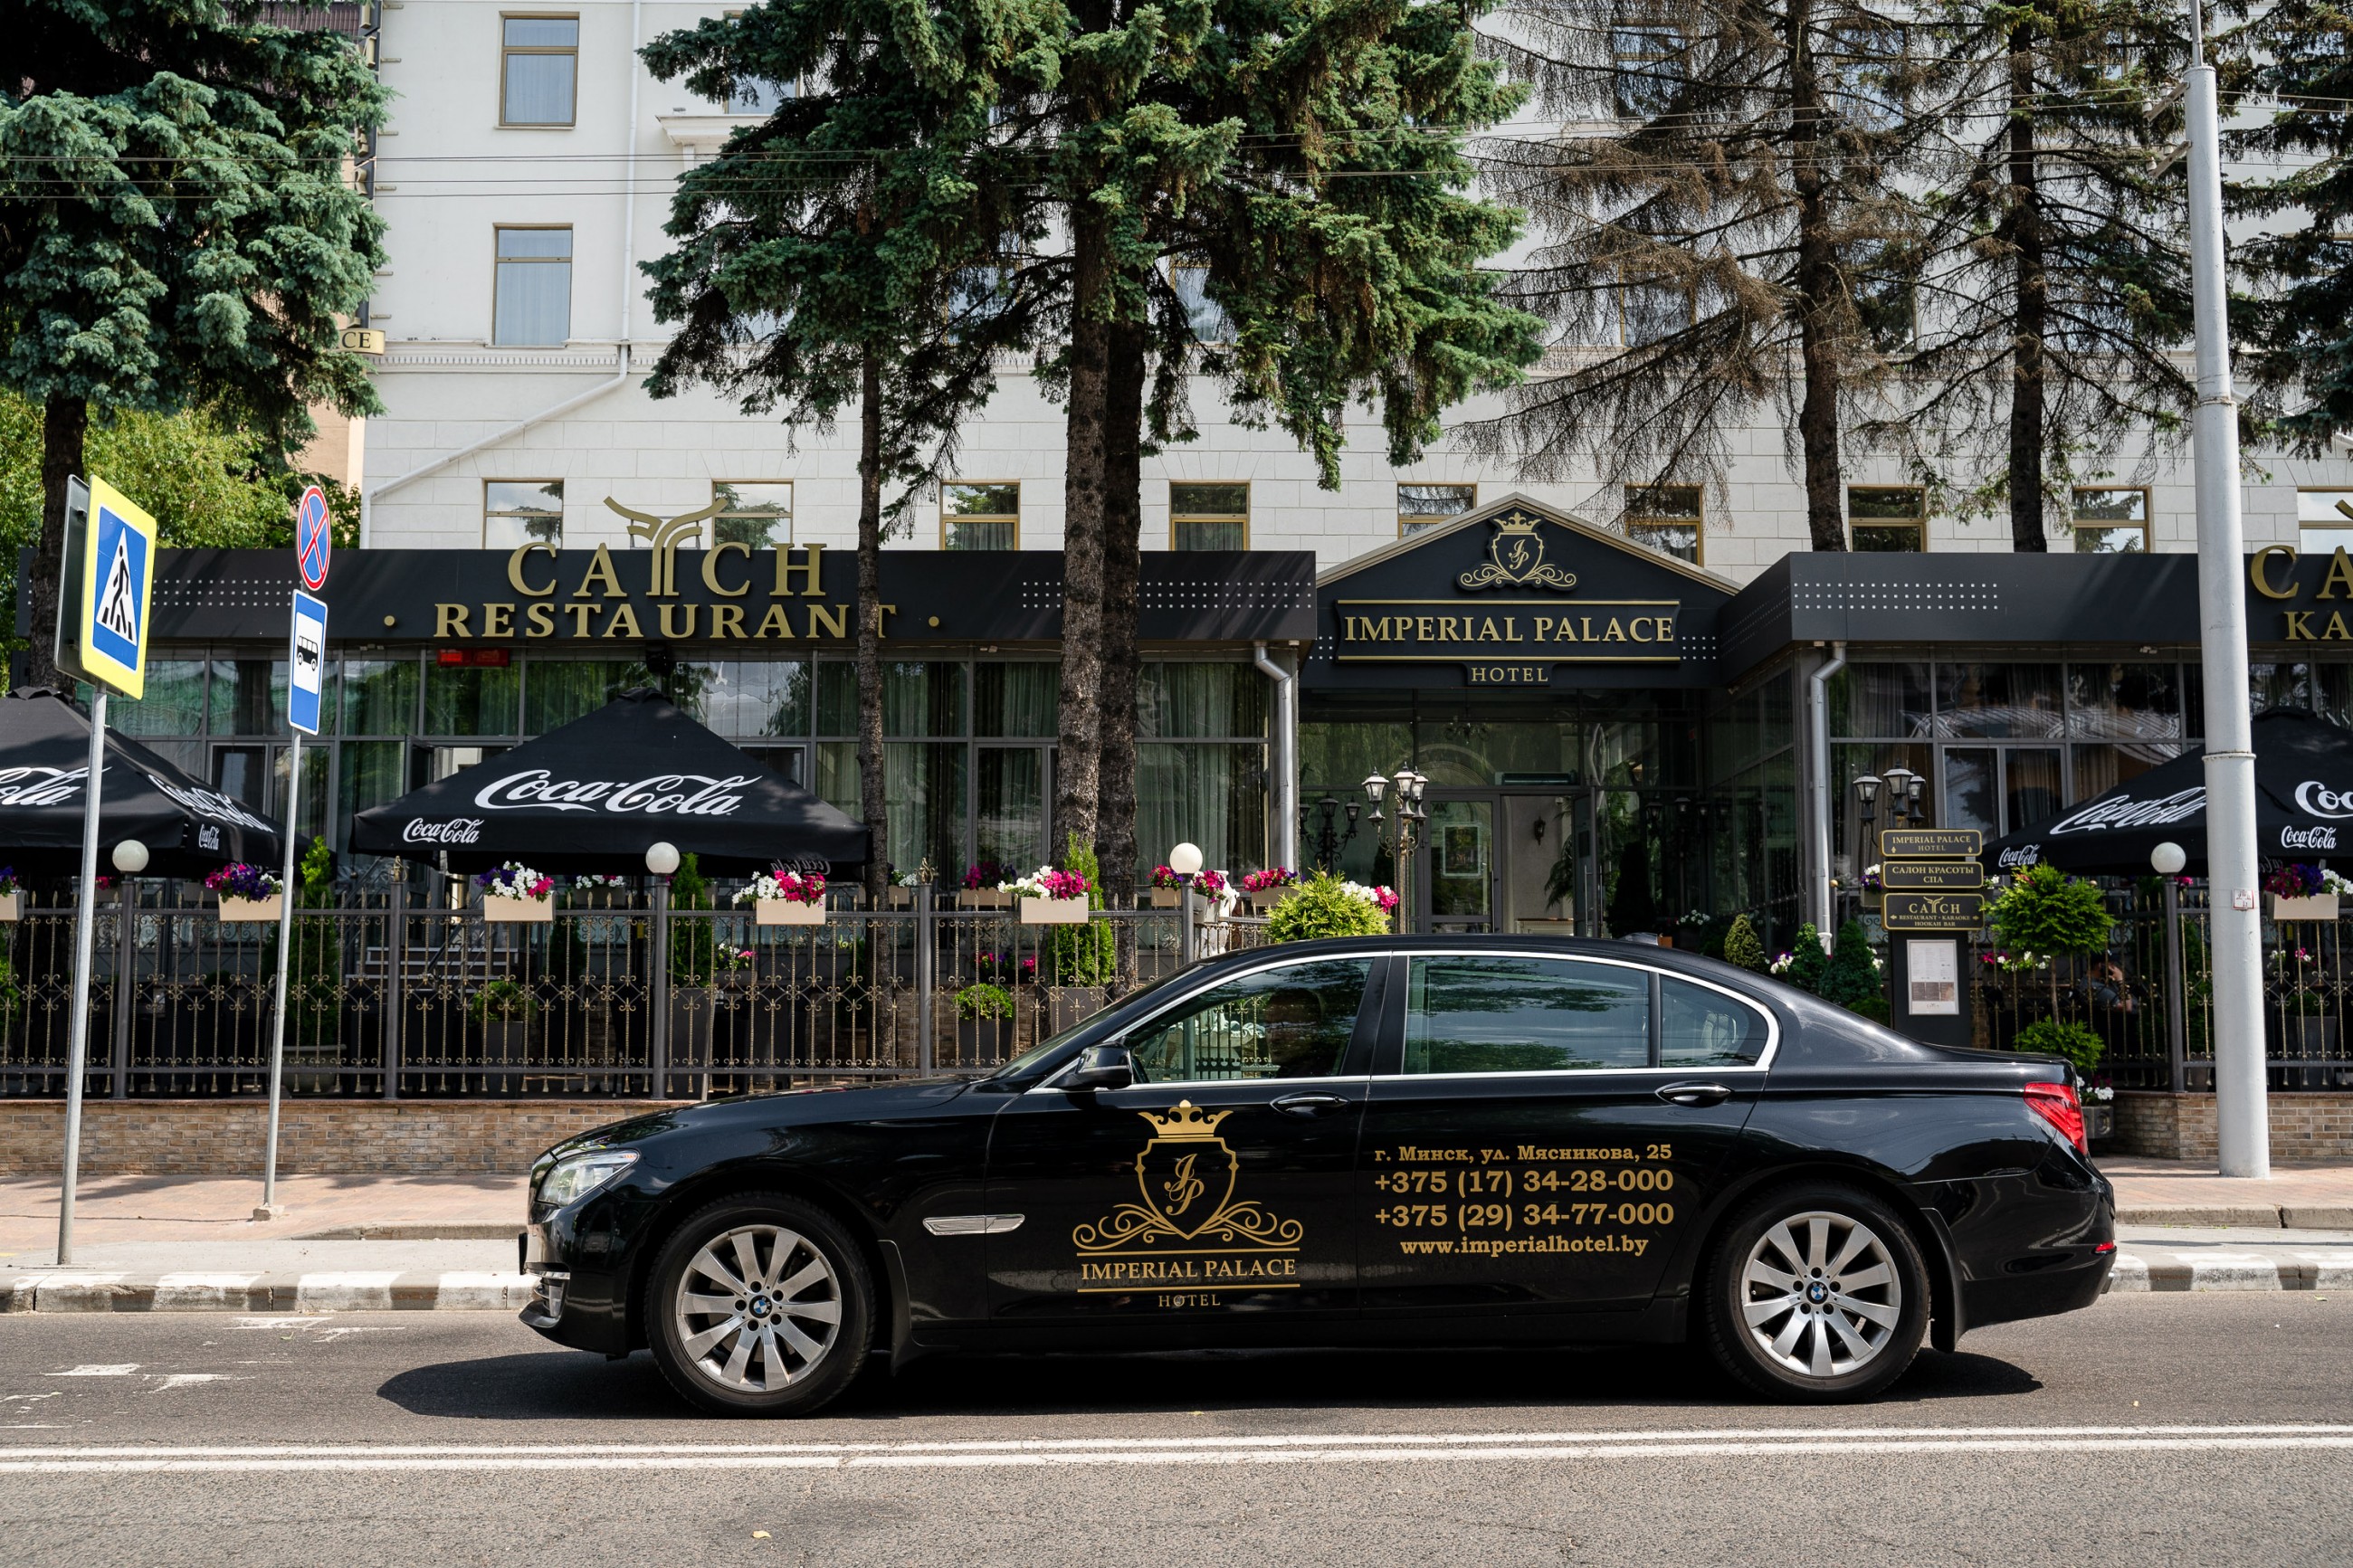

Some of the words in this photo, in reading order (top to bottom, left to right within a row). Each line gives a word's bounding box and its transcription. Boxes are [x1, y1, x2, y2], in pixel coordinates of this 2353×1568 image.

[340, 331, 371, 349] CE
[508, 497, 827, 597] CATCH
[2251, 544, 2353, 599] CA
[1344, 616, 1523, 641] IMPERIAL
[1533, 616, 1674, 642] PALACE
[1471, 667, 1548, 682] HOTEL
[474, 769, 763, 815] Coca-Cola
[403, 817, 485, 843] Coca-Cola
[1892, 836, 1935, 844] IMPERIAL
[1937, 835, 1971, 843] PALACE
[2282, 825, 2337, 850] Coca-Cola
[1891, 866, 1927, 874] САЛОН
[1929, 866, 1974, 874] КРАСОТЫ
[1909, 896, 1960, 914] CATCH
[1375, 1149, 1391, 1162] г.
[1398, 1146, 1474, 1164] Минск,
[1481, 1149, 1510, 1164] ул.
[1518, 1145, 1641, 1163] Мясникова,
[1646, 1144, 1672, 1159] 25
[1375, 1171, 1448, 1193] +375
[1458, 1170, 1513, 1199] (17)
[1523, 1169, 1674, 1193] 34-28-000
[1375, 1204, 1448, 1227] +375
[1458, 1203, 1513, 1232] (29)
[1523, 1202, 1674, 1225] 34-77-000
[1400, 1235, 1649, 1258] www.imperialhotel.by
[1081, 1260, 1198, 1280] IMPERIAL
[1204, 1259, 1297, 1278] PALACE
[1157, 1294, 1221, 1307] HOTEL
